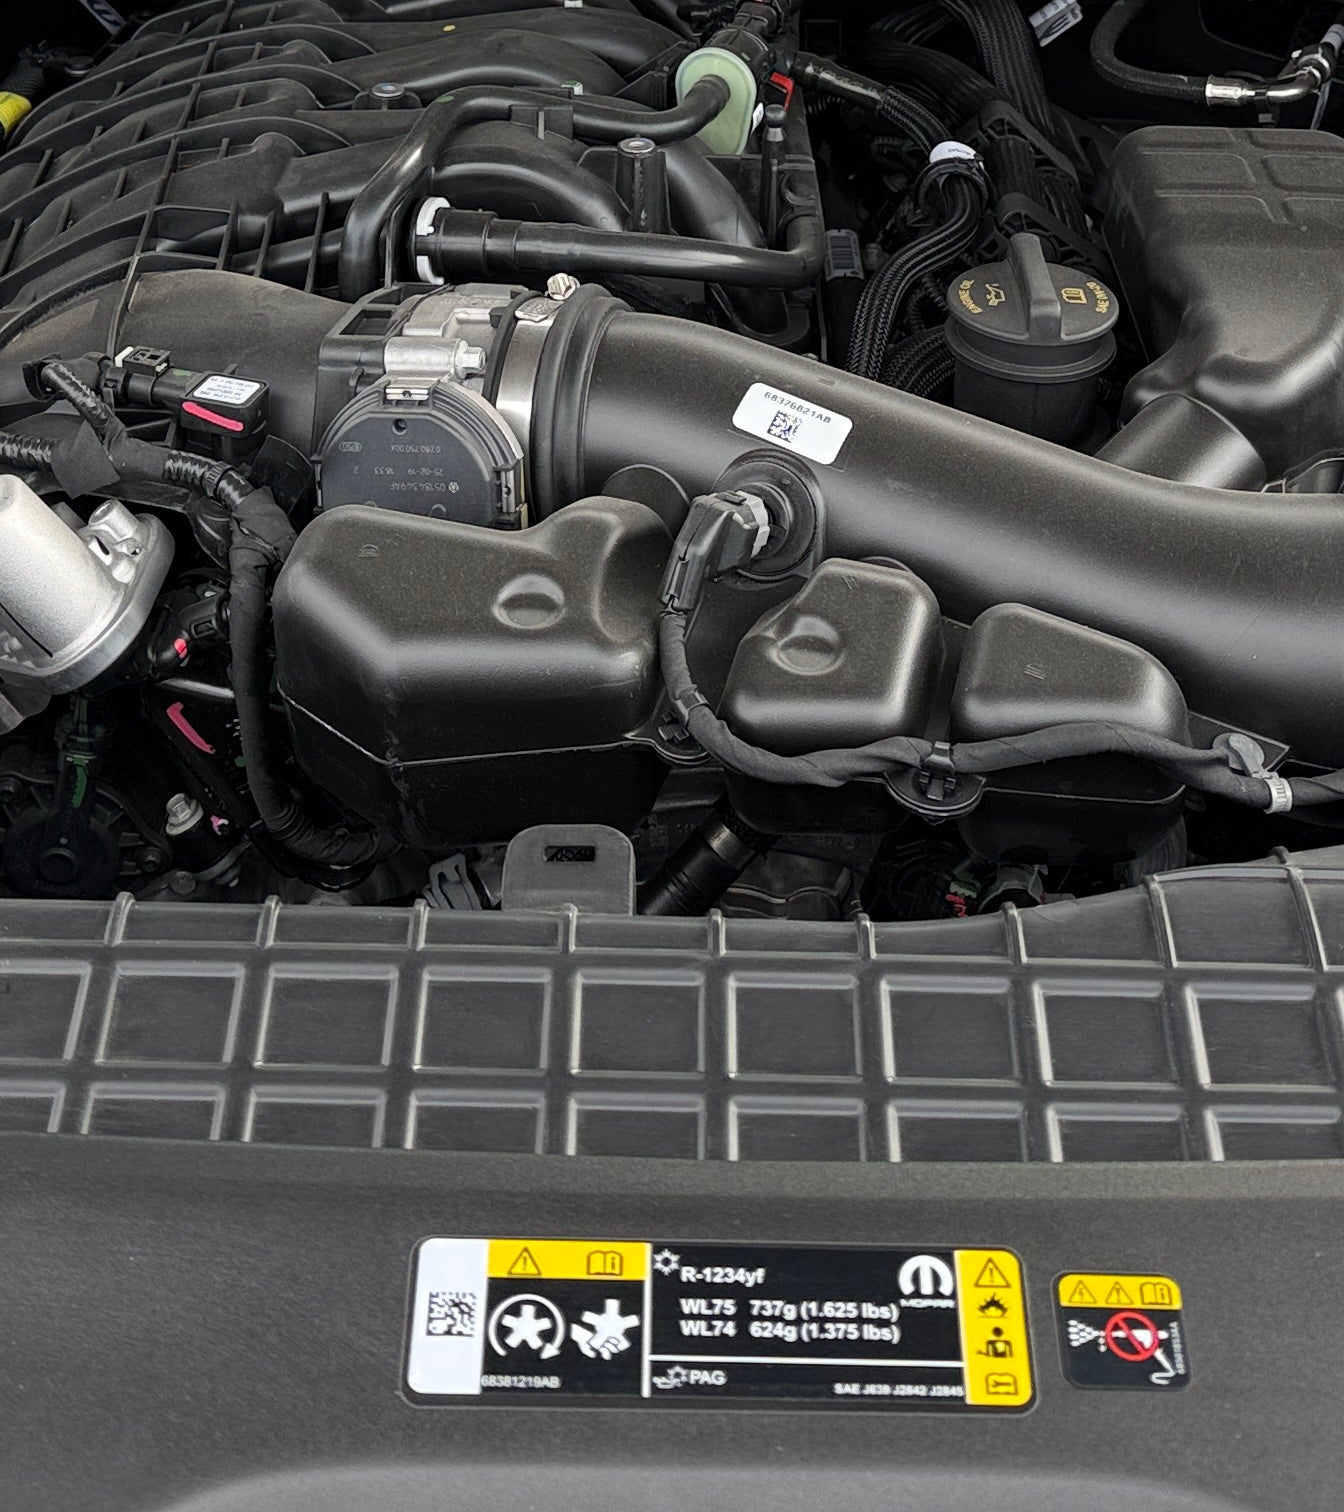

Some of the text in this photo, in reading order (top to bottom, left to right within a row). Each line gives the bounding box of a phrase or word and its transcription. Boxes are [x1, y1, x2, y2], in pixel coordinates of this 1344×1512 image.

[680, 1266, 767, 1288] R-1234yf
[679, 1298, 901, 1323] WL75 737g (1.625 lbs)
[899, 1298, 955, 1309] MOPAR
[679, 1320, 902, 1345] WL74 624g (1.375 lbs)
[480, 1374, 561, 1389] 68381219AB
[689, 1370, 728, 1386] PAG
[833, 1382, 861, 1395] SAE
